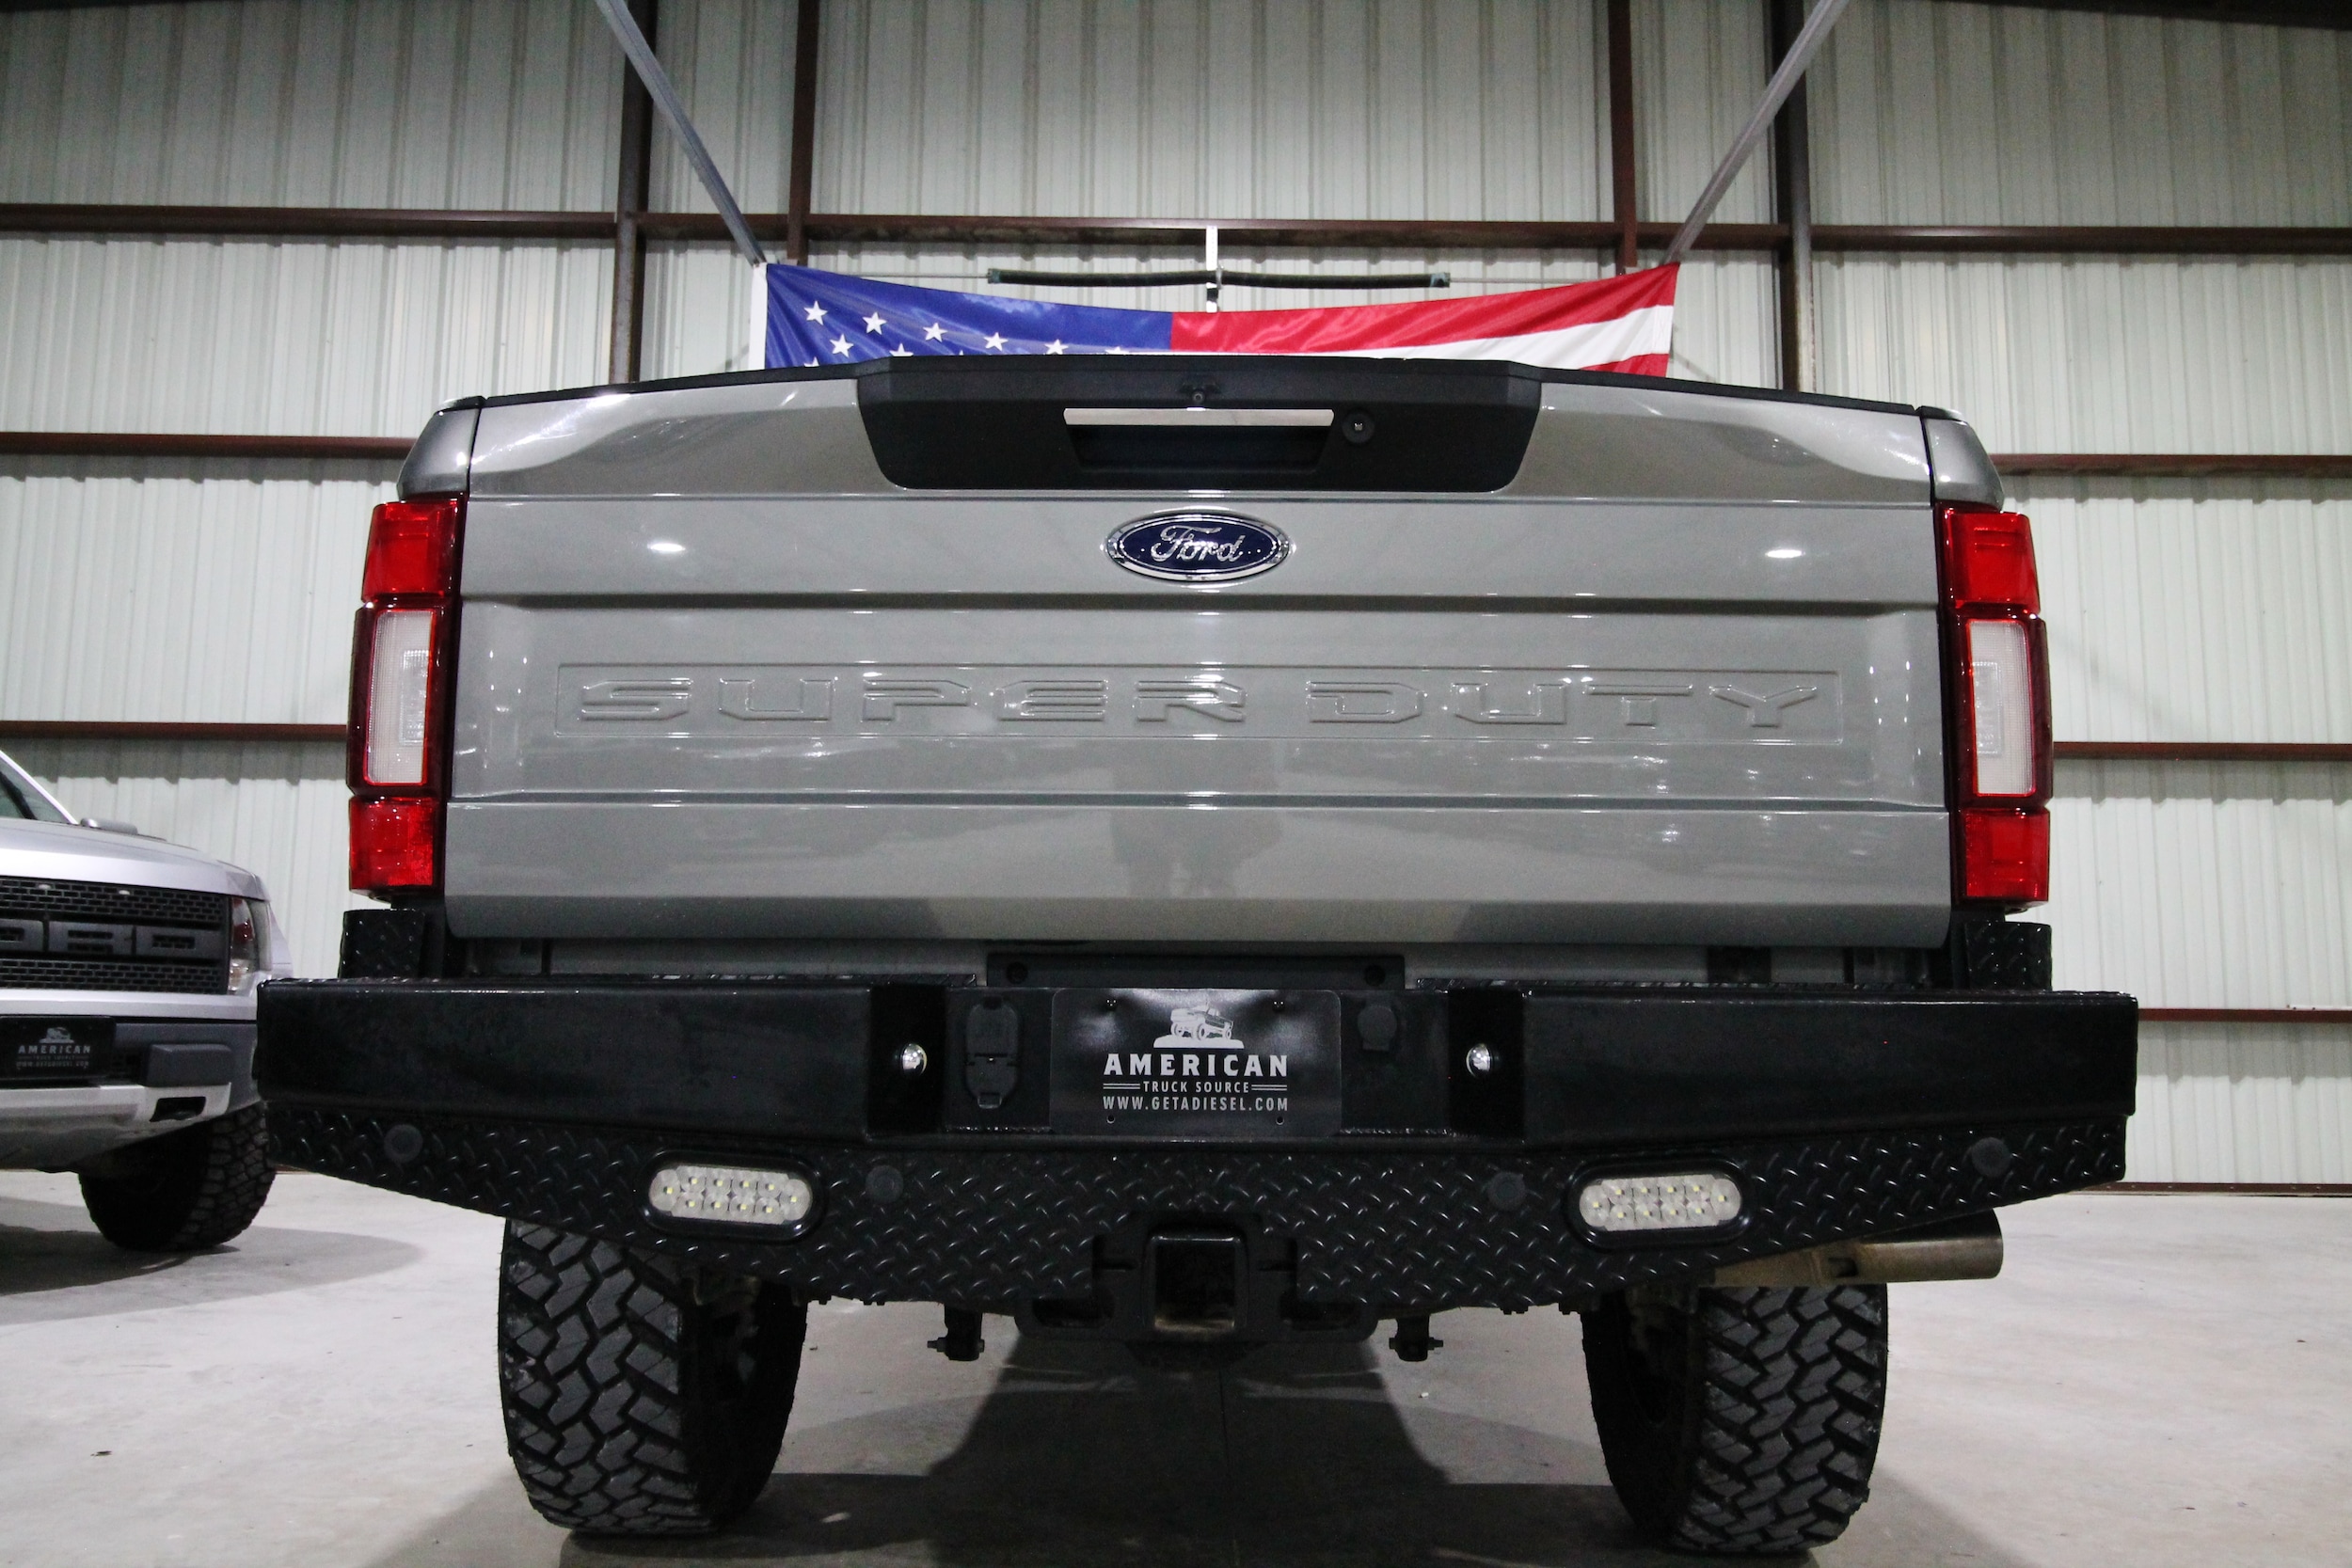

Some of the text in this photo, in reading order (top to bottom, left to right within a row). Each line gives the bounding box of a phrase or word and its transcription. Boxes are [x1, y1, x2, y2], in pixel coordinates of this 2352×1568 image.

[1151, 525, 1246, 562] Ford
[578, 677, 1818, 728] SUPER DUTY
[19, 1045, 91, 1053] AMERICAN
[1104, 1053, 1288, 1077] AMERICAN
[1143, 1081, 1249, 1094] TRUCK SOURCE
[1103, 1096, 1288, 1112] WWW.GETADIESEL.COM
